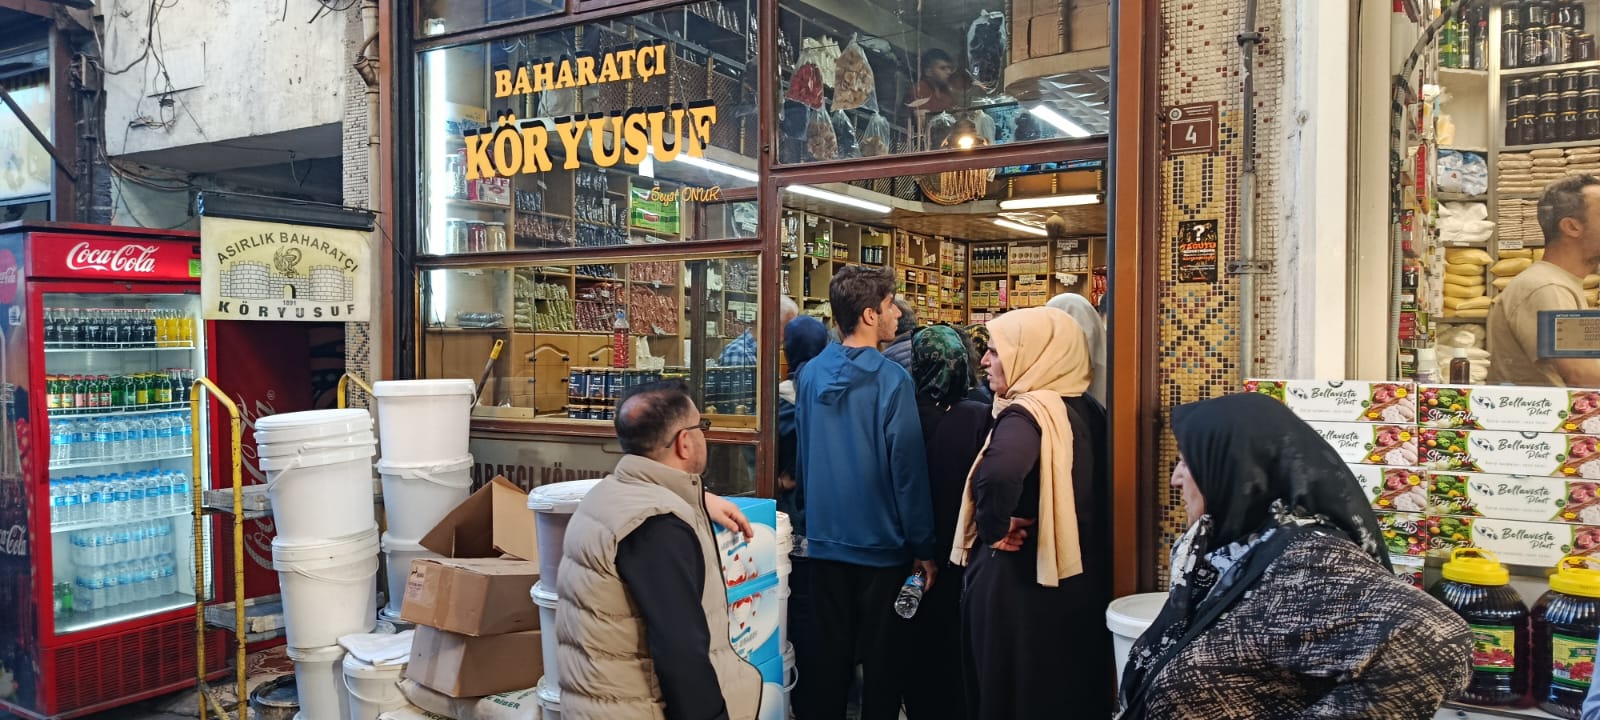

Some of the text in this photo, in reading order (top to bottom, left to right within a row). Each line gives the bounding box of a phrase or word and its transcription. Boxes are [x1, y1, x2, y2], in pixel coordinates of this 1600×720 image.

[494, 44, 666, 98] BAHARATÇI
[463, 104, 717, 181] KÖR YUSUF
[1185, 125, 1197, 145] 4
[66, 242, 160, 273] Coca-Cola
[217, 232, 358, 273] ASIRLIK BAHARATÇI
[1311, 387, 1357, 399] Bellavista
[1498, 396, 1552, 408] Bellavista
[1497, 438, 1551, 451] Bellavista
[1497, 484, 1550, 496] Bellavista
[1501, 527, 1556, 541] Bellavista
